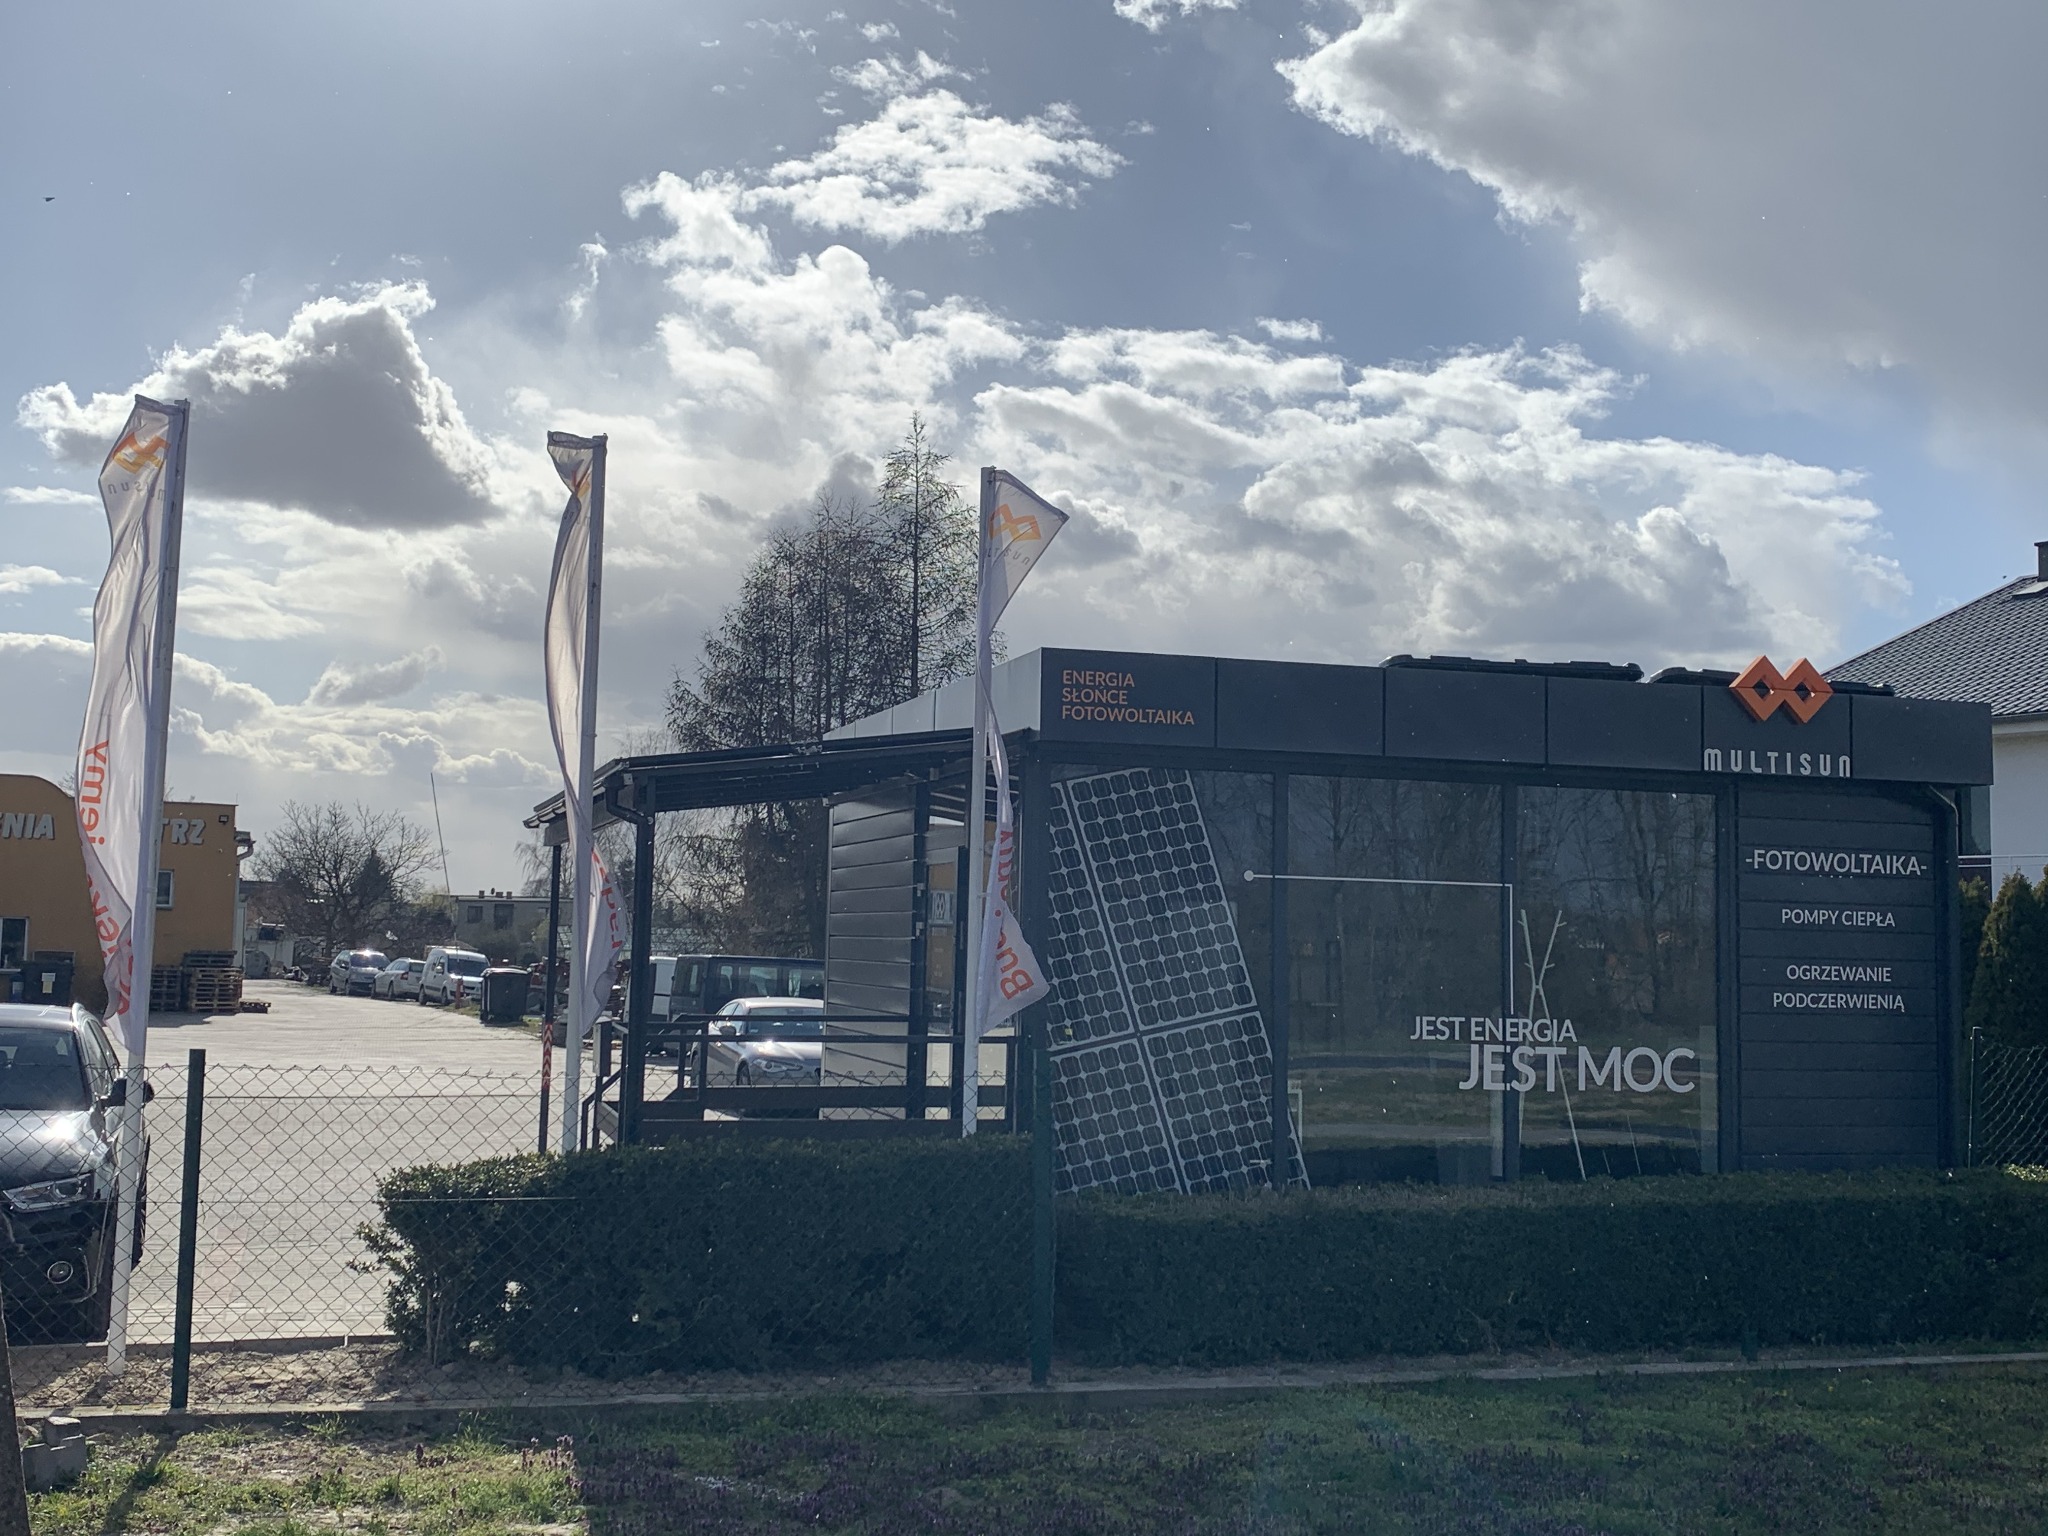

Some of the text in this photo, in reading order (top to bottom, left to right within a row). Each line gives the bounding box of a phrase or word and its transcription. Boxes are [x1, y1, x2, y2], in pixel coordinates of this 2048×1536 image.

[1062, 670, 1135, 687] ENERGIA
[1062, 686, 1128, 704] SŁOŃCE
[1062, 705, 1195, 725] FOTOWOLTAIKA
[0, 812, 54, 840] NIA
[1781, 909, 1896, 927] POMPY CIEPŁA
[1786, 965, 1892, 982] OGRZEWANIE
[1773, 992, 1905, 1012] PODCZERWIENIĄ
[1410, 1016, 1577, 1042] JEST ENERGIA
[1459, 1044, 1696, 1093] JEST MOC
